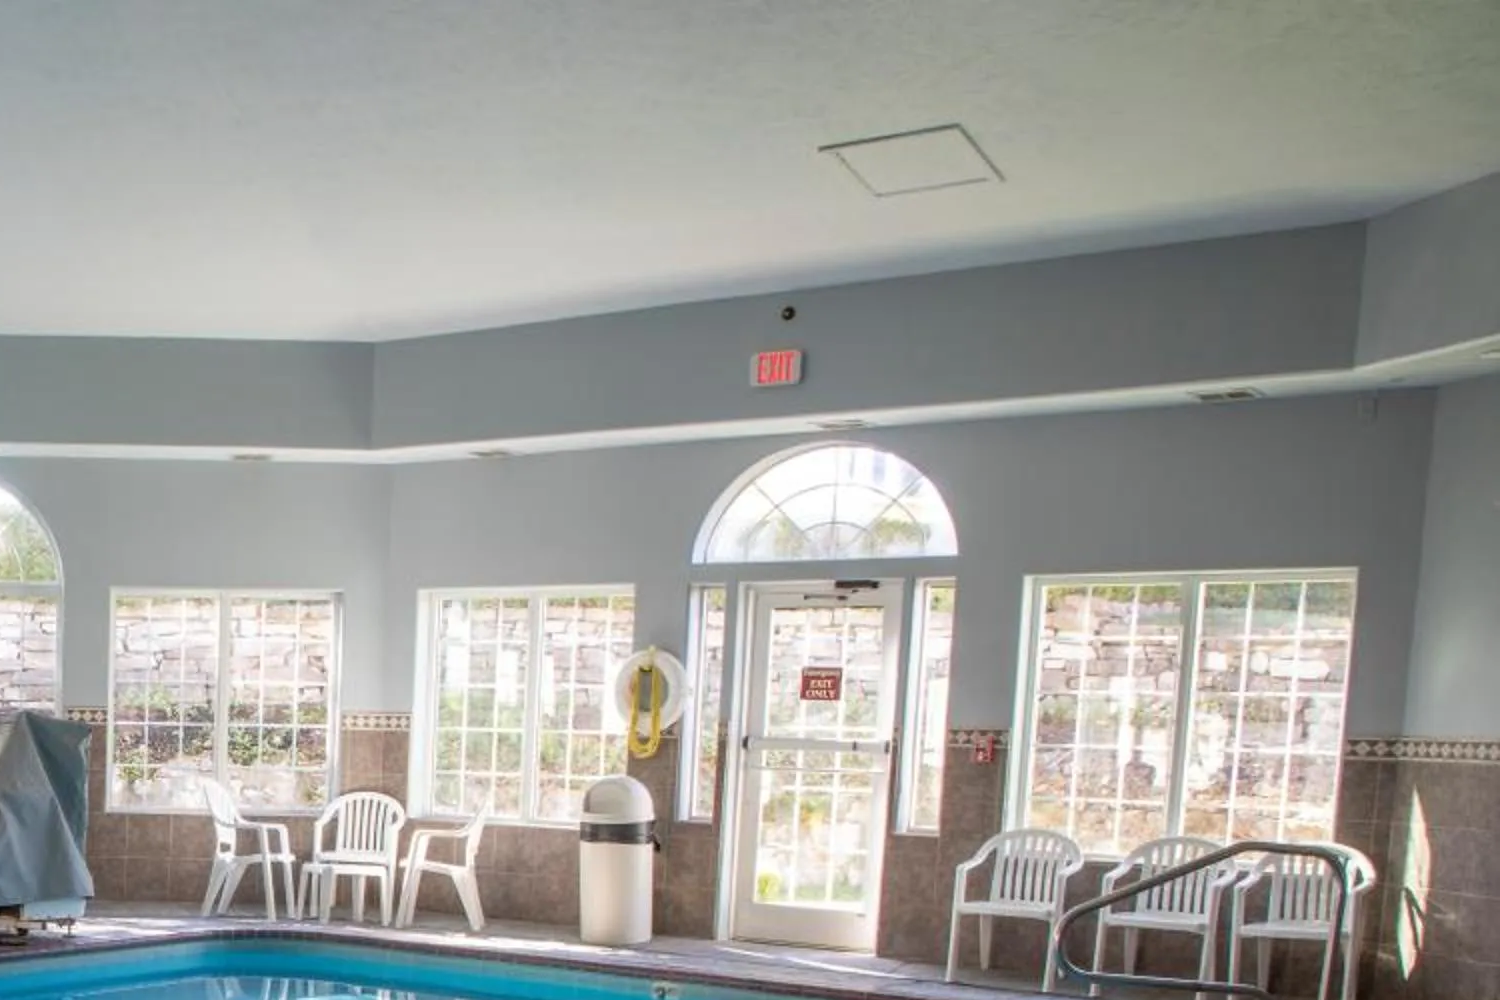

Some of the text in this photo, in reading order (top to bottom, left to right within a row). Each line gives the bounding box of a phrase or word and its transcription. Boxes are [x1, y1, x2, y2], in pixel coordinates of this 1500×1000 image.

[757, 351, 795, 384] EXIT
[809, 679, 832, 689] EXIT
[805, 689, 837, 699] ONLY
